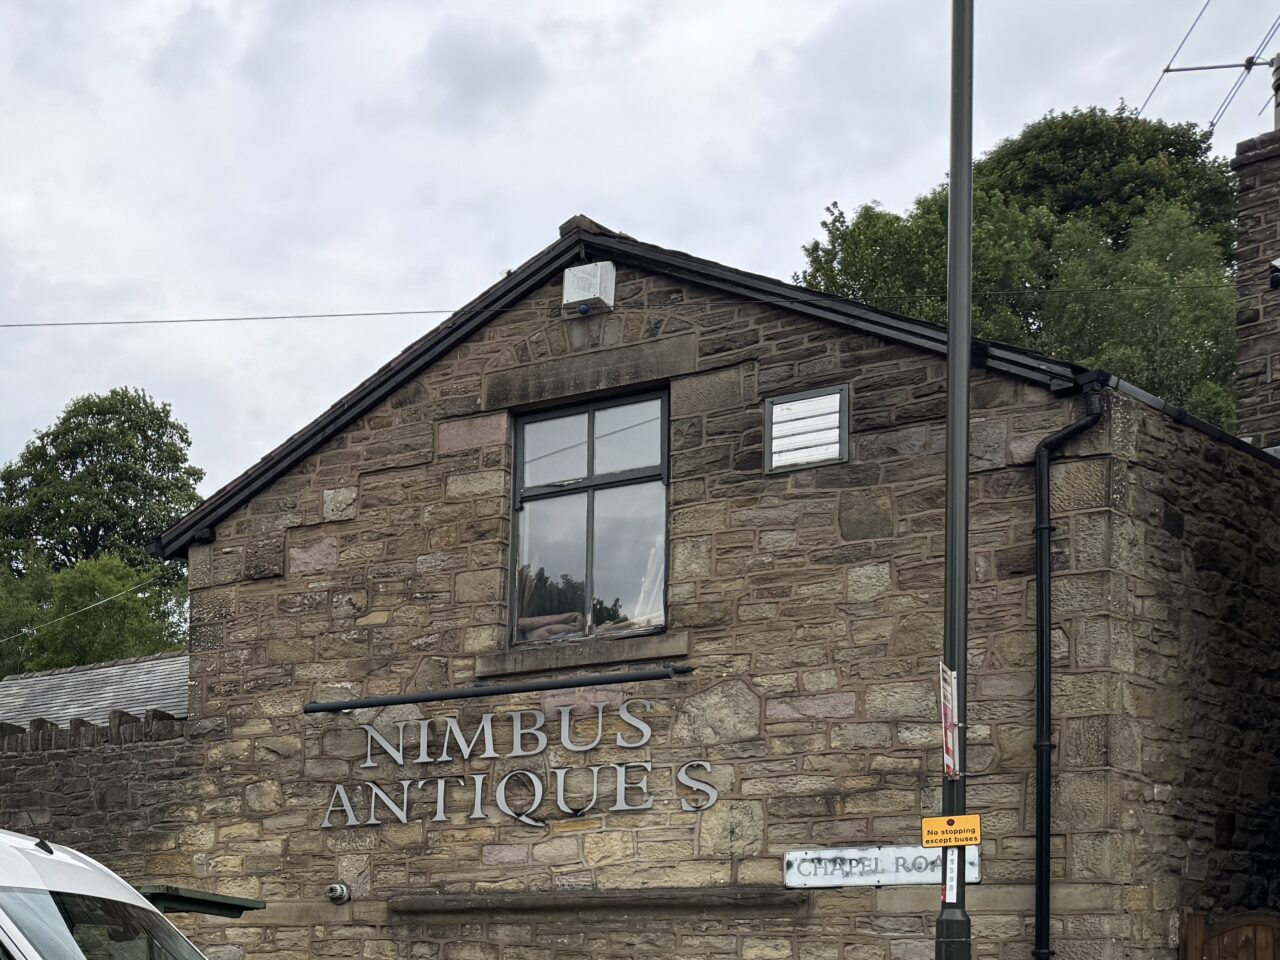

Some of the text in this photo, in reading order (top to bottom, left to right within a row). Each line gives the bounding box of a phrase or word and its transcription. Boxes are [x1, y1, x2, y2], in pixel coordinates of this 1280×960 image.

[359, 698, 654, 769] NIMBUS
[320, 759, 719, 828] ANTIQUES
[796, 855, 942, 877] CHAPEL ROA
